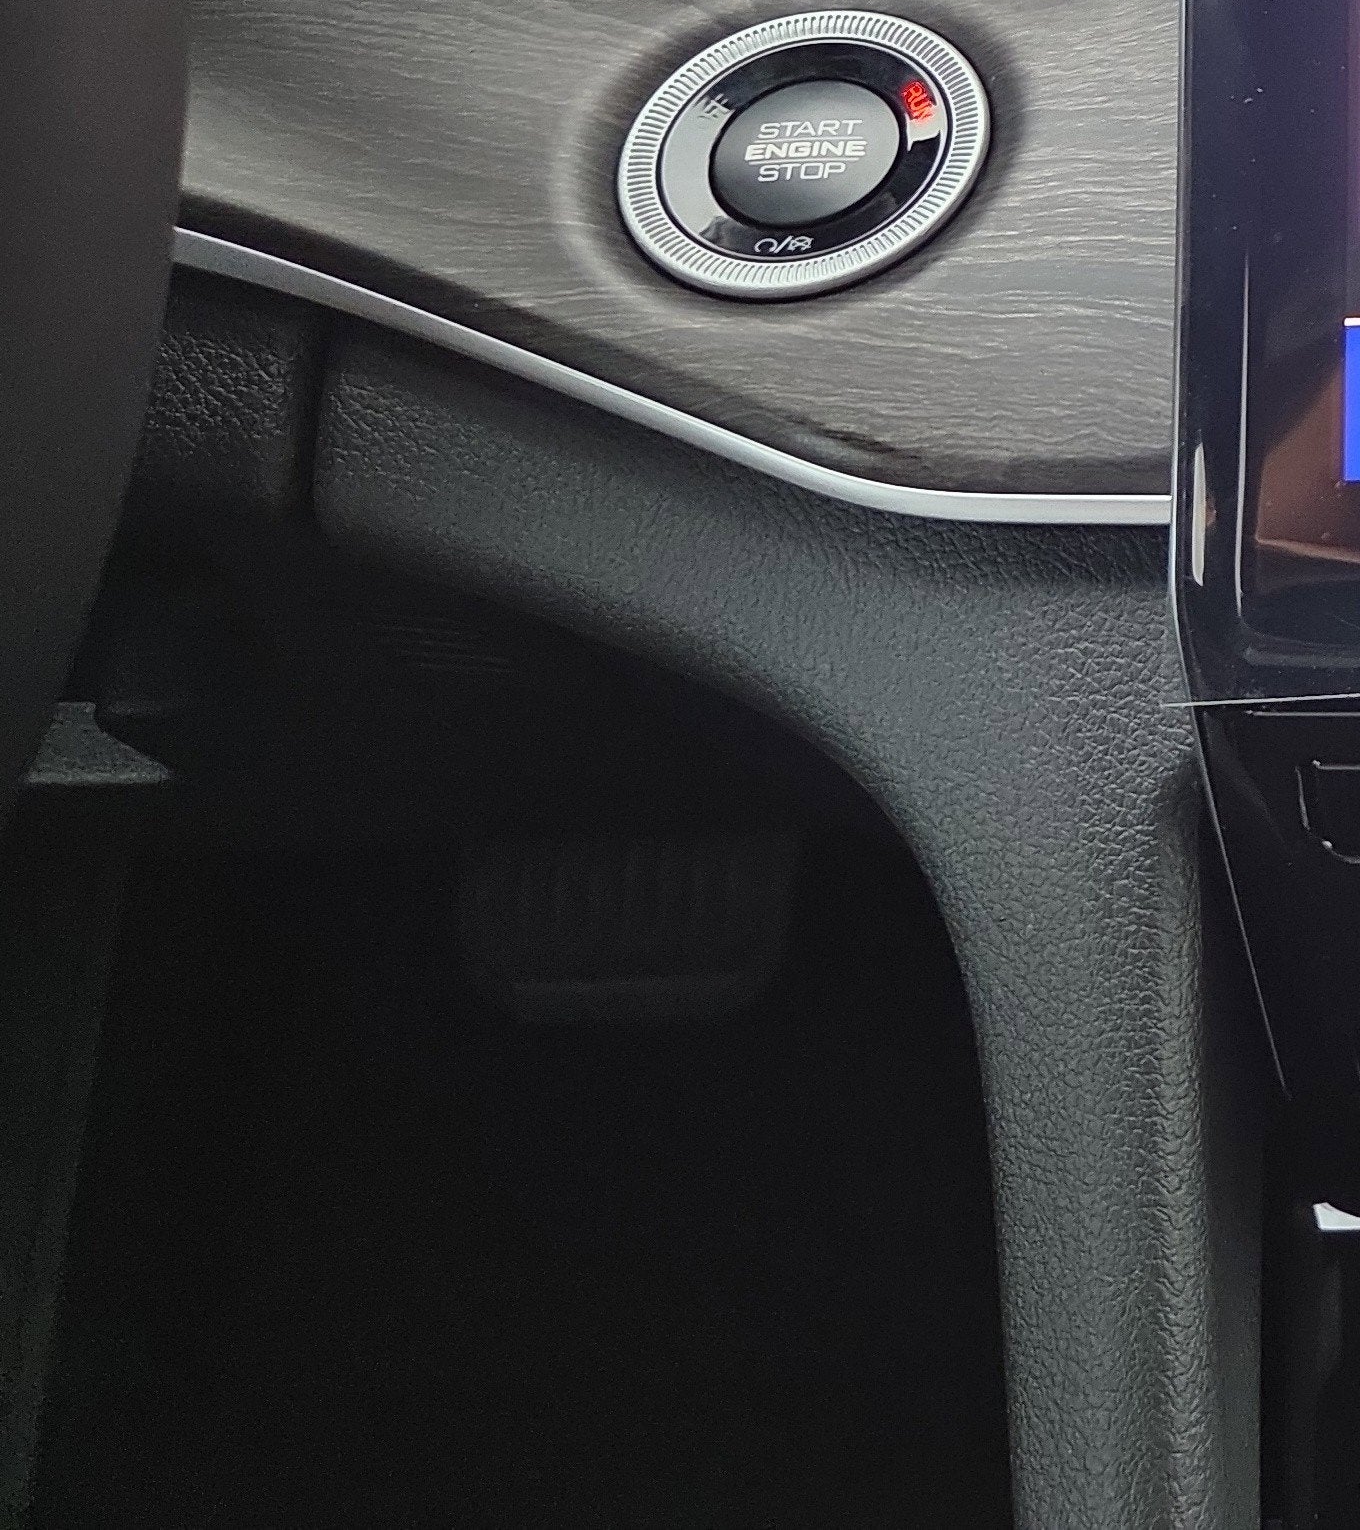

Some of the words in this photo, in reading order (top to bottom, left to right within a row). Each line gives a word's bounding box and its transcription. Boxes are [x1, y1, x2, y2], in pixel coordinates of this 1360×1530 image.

[757, 118, 863, 140] START
[743, 140, 868, 162] ENGINE
[757, 161, 847, 184] STOP
